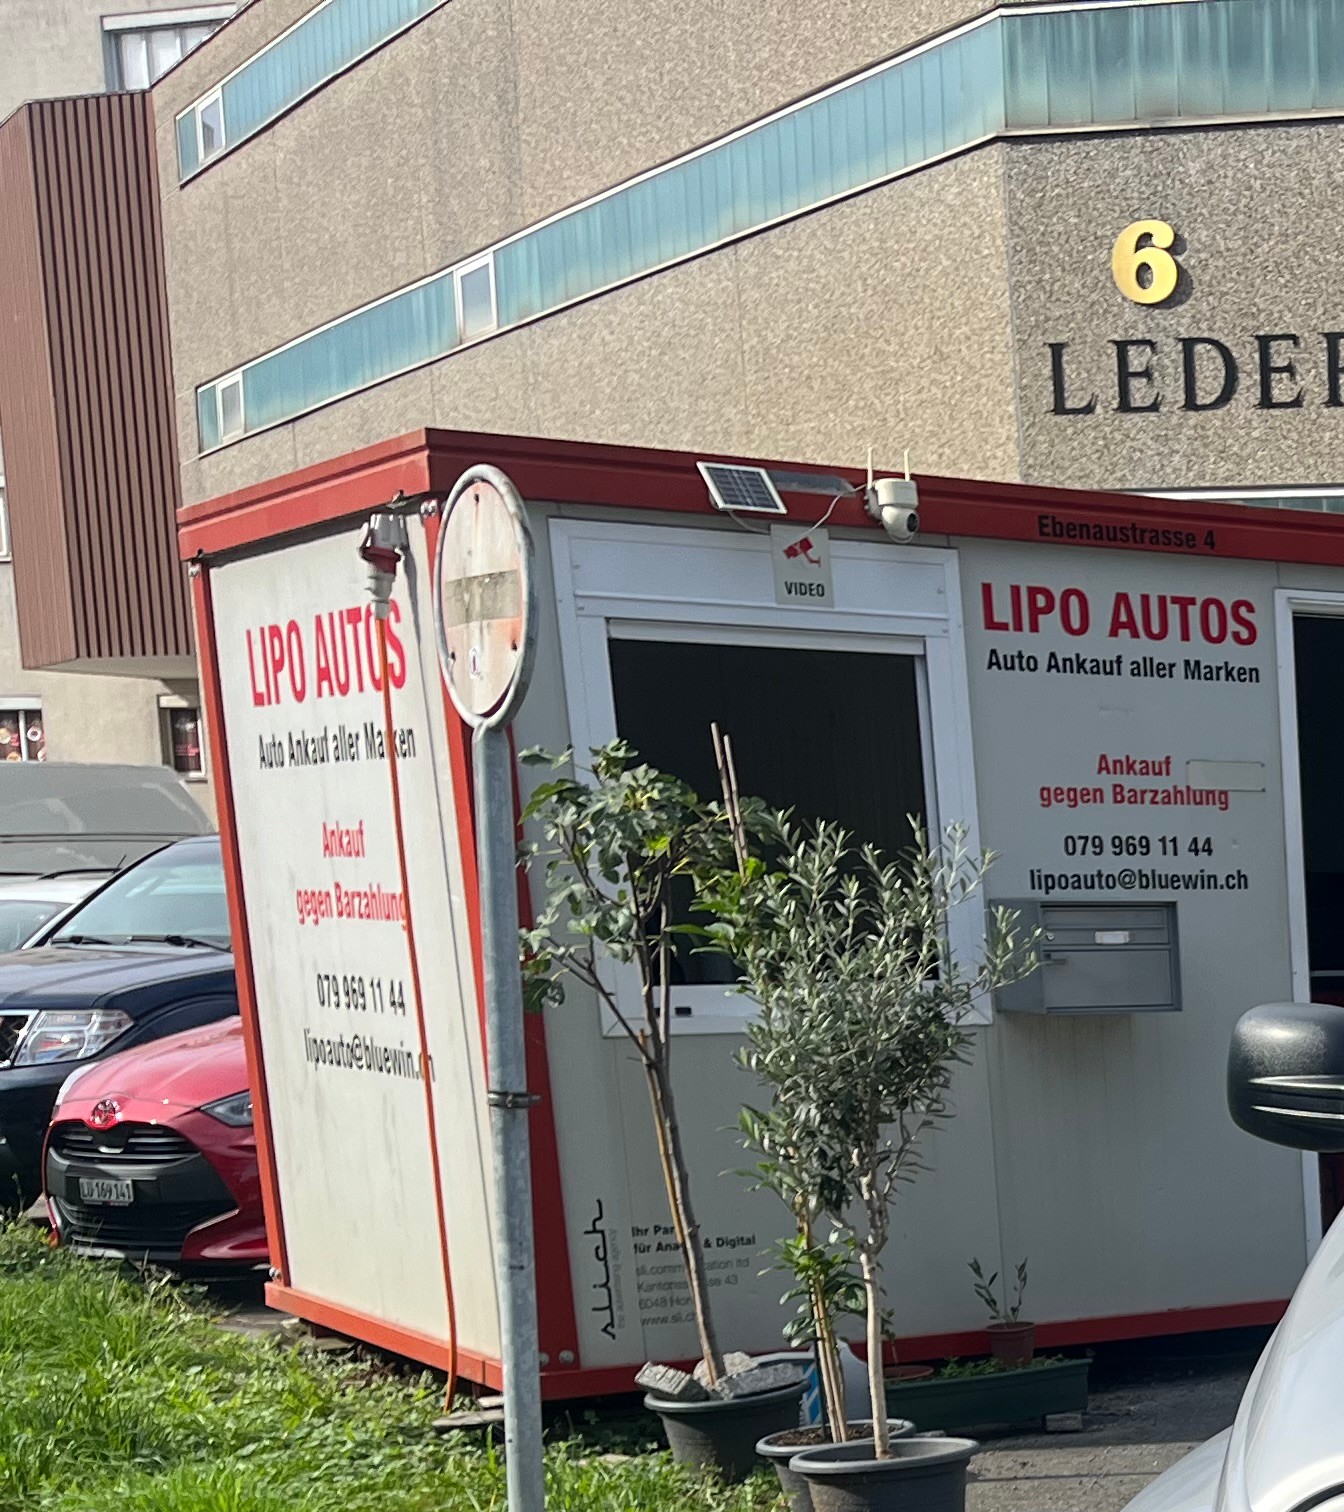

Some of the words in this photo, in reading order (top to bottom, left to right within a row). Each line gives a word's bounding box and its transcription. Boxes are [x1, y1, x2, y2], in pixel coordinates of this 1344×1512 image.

[1112, 219, 1178, 305] 6
[1037, 514, 1196, 549] Ebenaustrasse
[1203, 529, 1216, 550] 4
[784, 580, 825, 598] VIDEO
[981, 582, 1090, 637] LIPO
[1107, 591, 1258, 647] AUTOS
[245, 618, 306, 708] LIPO
[987, 648, 1039, 673] Auto
[1046, 651, 1123, 678] Ankauf
[1129, 655, 1177, 679] aller
[1184, 658, 1261, 684] Marken
[258, 733, 285, 770] Auto
[287, 724, 330, 768] Ankauf
[332, 724, 360, 764] aller
[363, 719, 417, 760] Maken
[1097, 753, 1172, 777] Ankauf
[1039, 785, 1105, 809] gegen
[1112, 783, 1230, 812] Barzahlung
[322, 819, 366, 859] Ankauf
[1063, 834, 1104, 857] 079
[1111, 835, 1151, 857] 969
[1158, 836, 1178, 857] 11
[1187, 836, 1214, 857] 44
[1029, 867, 1250, 896] lipoauto@bluewin.ch
[296, 888, 333, 927] gegen
[317, 973, 340, 1010] 079
[343, 974, 367, 1012] 969
[369, 977, 384, 1014] 11
[389, 978, 406, 1017] 44
[631, 1225, 650, 1238] Ihr
[703, 1237, 712, 1249] &
[716, 1234, 756, 1250] Digital
